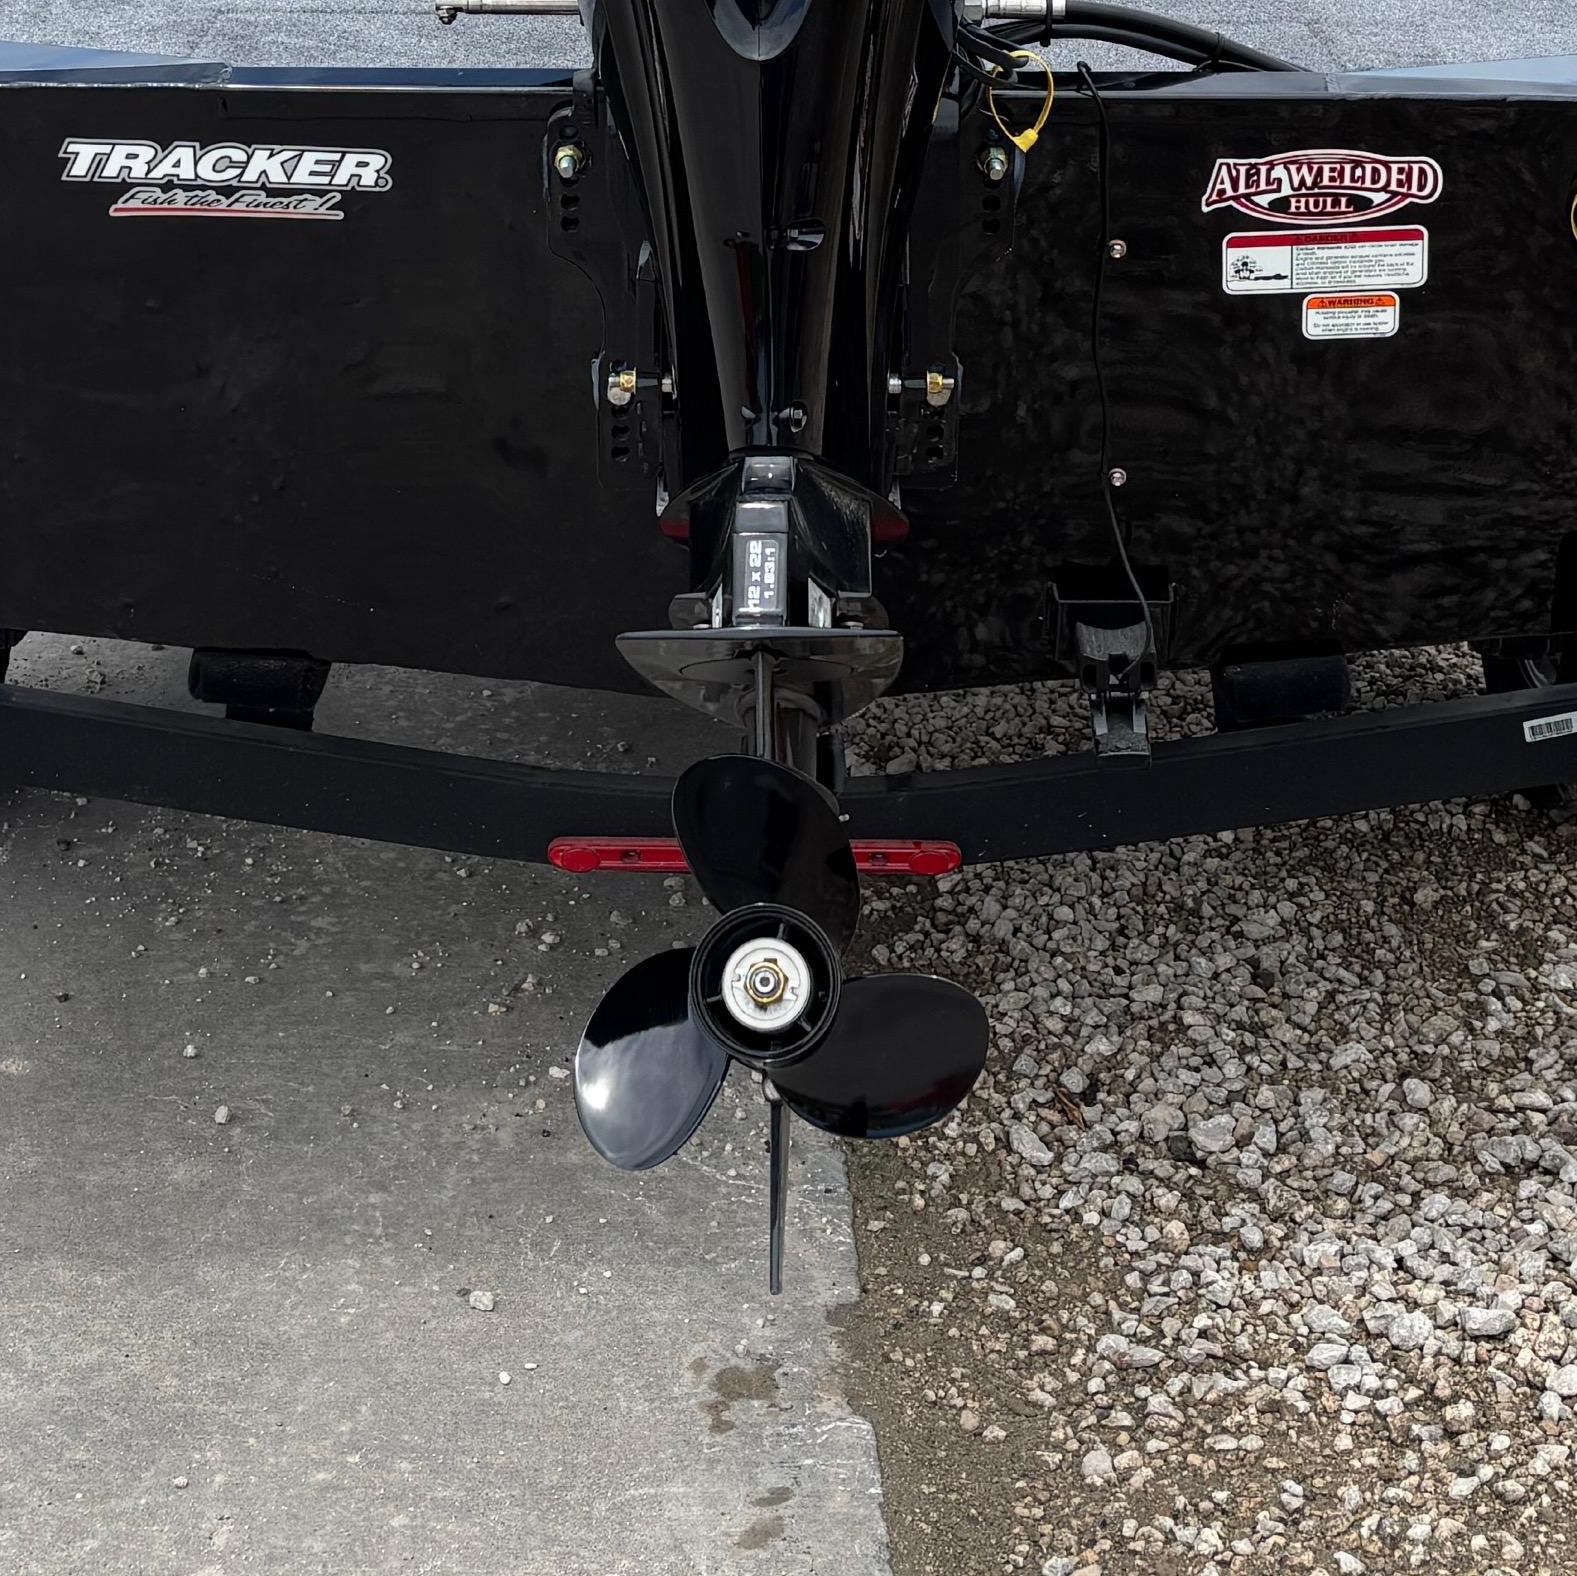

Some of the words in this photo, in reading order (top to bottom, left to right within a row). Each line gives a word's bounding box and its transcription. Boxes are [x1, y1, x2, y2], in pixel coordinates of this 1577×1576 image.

[61, 140, 388, 189] TRACKER
[1206, 162, 1281, 205] ALL
[1283, 162, 1434, 197] WELDED
[122, 189, 179, 206] Fish
[182, 192, 224, 207] the
[1288, 196, 1355, 213] HULL
[1328, 297, 1375, 307] WARNING
